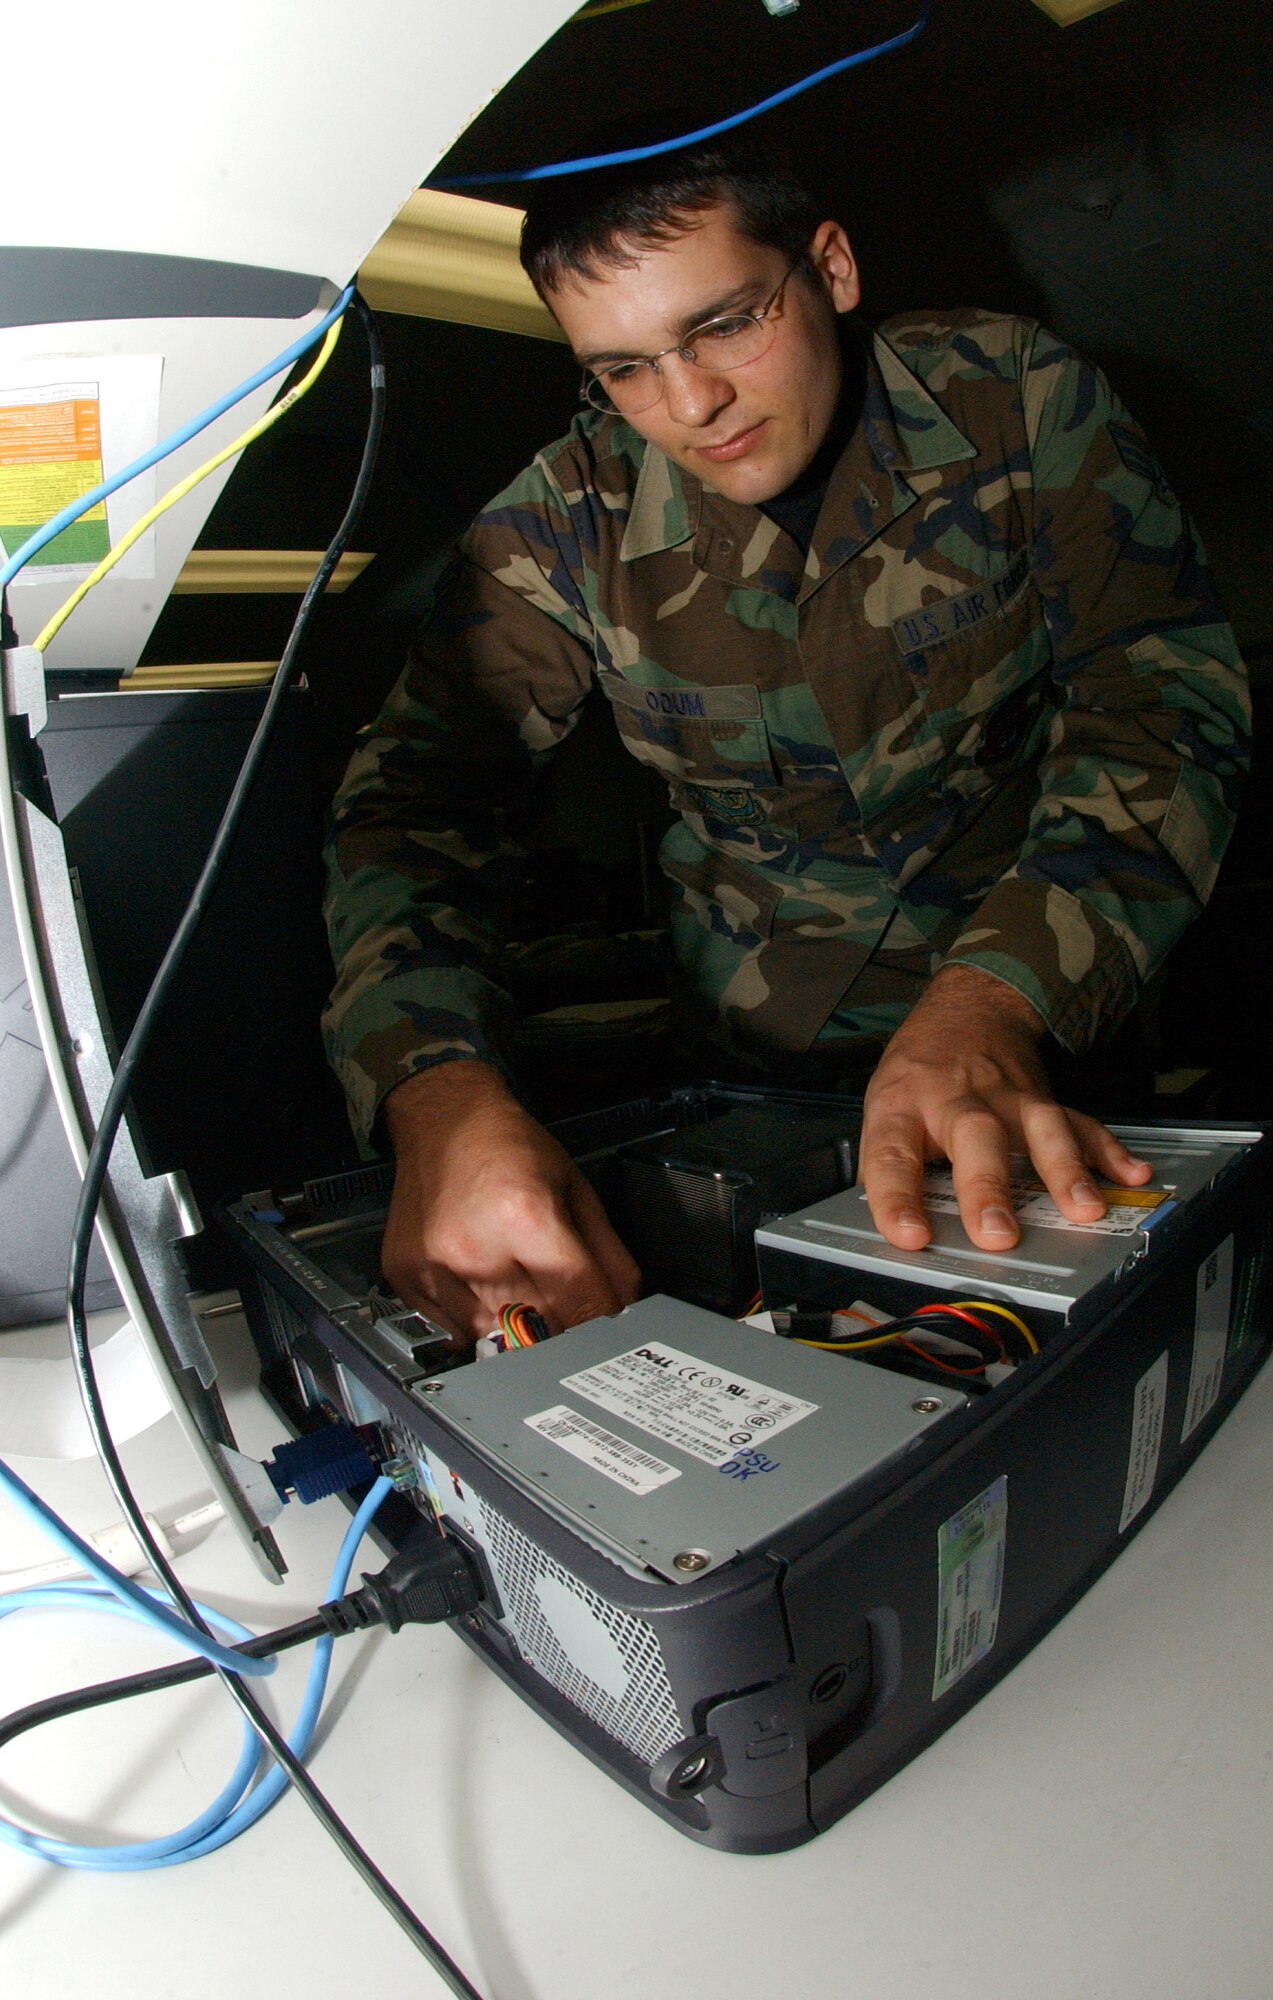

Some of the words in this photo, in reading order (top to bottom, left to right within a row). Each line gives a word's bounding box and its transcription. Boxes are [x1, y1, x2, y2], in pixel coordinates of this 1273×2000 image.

[903, 613, 946, 646] U.S.
[950, 592, 989, 630] AIR
[645, 691, 706, 718] ODUM
[634, 1348, 674, 1368] DELL
[591, 1455, 609, 1468] MADE
[617, 1471, 640, 1486] CHINA
[719, 1461, 759, 1482] OK
[733, 1447, 781, 1473] PSU
